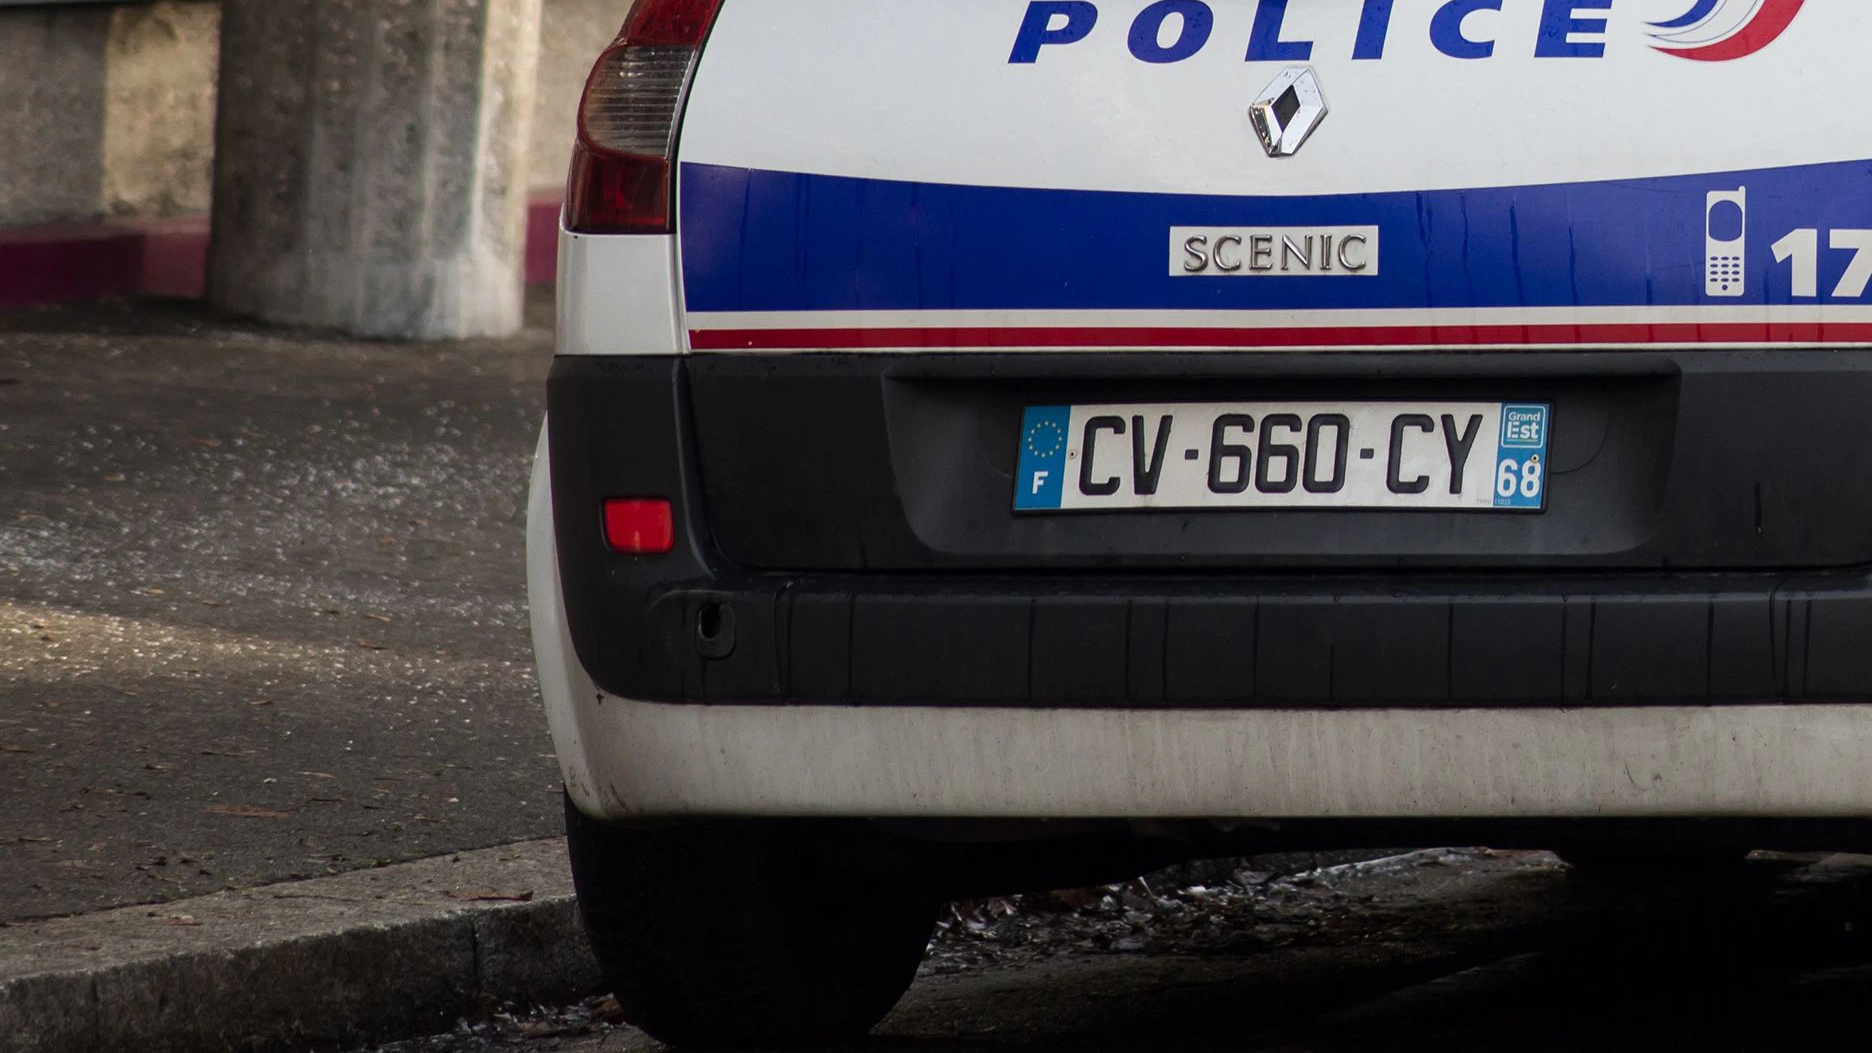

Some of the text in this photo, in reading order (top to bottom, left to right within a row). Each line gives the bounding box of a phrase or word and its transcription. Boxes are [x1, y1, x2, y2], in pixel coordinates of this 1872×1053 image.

[1184, 234, 1368, 272] SCENIC
[1506, 421, 1539, 439] Est
[1507, 411, 1541, 422] Grand
[1079, 413, 1484, 496] CV-660-CY
[1032, 470, 1048, 495] F
[1496, 458, 1542, 498] 68
